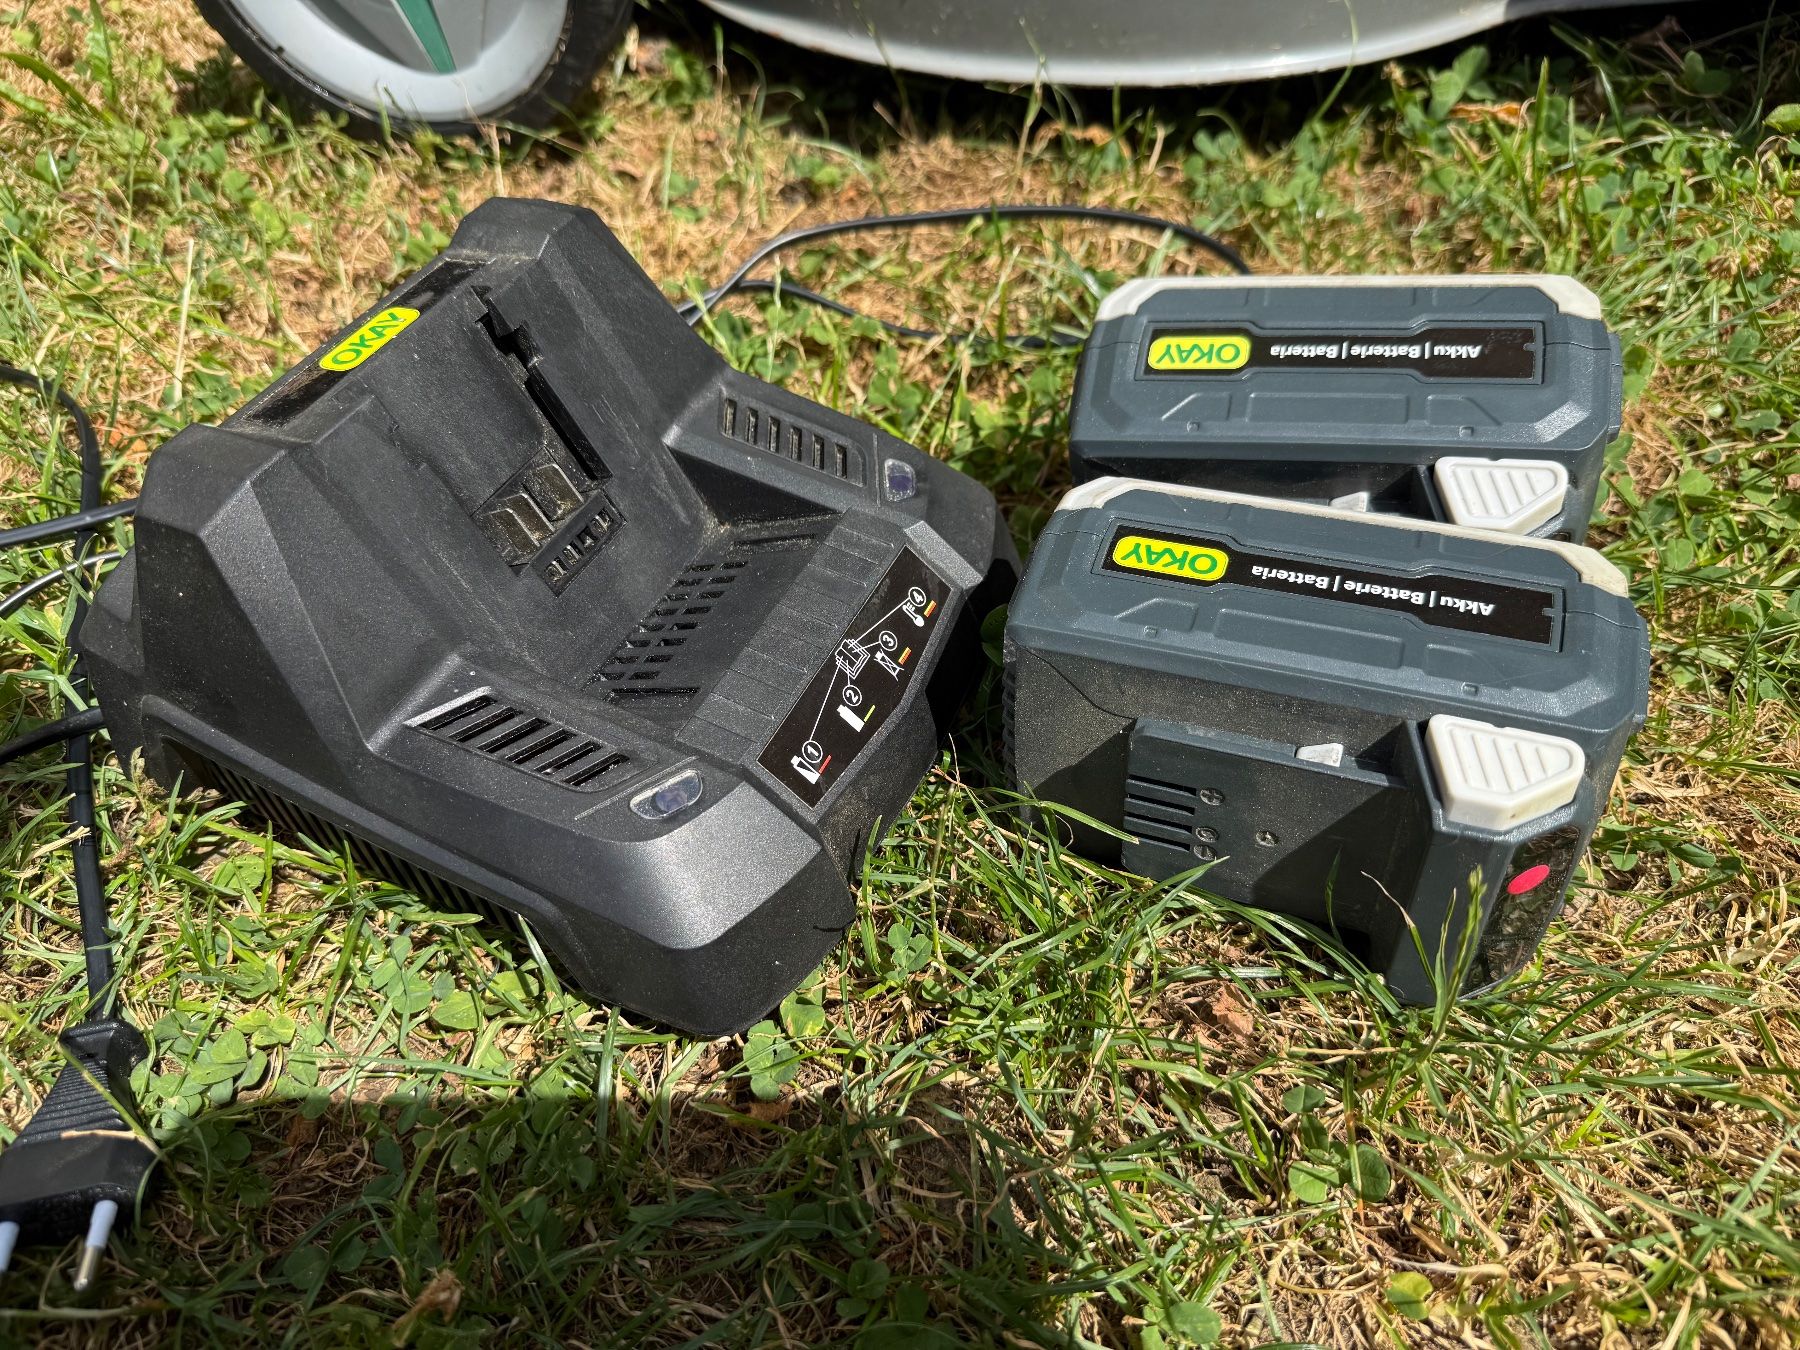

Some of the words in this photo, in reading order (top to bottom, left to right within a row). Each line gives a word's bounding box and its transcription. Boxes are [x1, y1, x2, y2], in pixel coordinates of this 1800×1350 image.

[332, 312, 406, 365] OKAY
[1156, 343, 1241, 364] OKAY
[1270, 343, 1339, 359] Batteria
[1350, 343, 1422, 359] Batterie
[1433, 344, 1483, 359] Akku
[1120, 543, 1218, 575] OKAY
[1251, 565, 1330, 590] Batteria
[912, 590, 924, 603] 4
[1343, 580, 1427, 607] Batterie
[1439, 595, 1496, 616] Akku
[882, 634, 895, 647] 3
[845, 689, 859, 704] 2
[806, 744, 819, 757] 1
